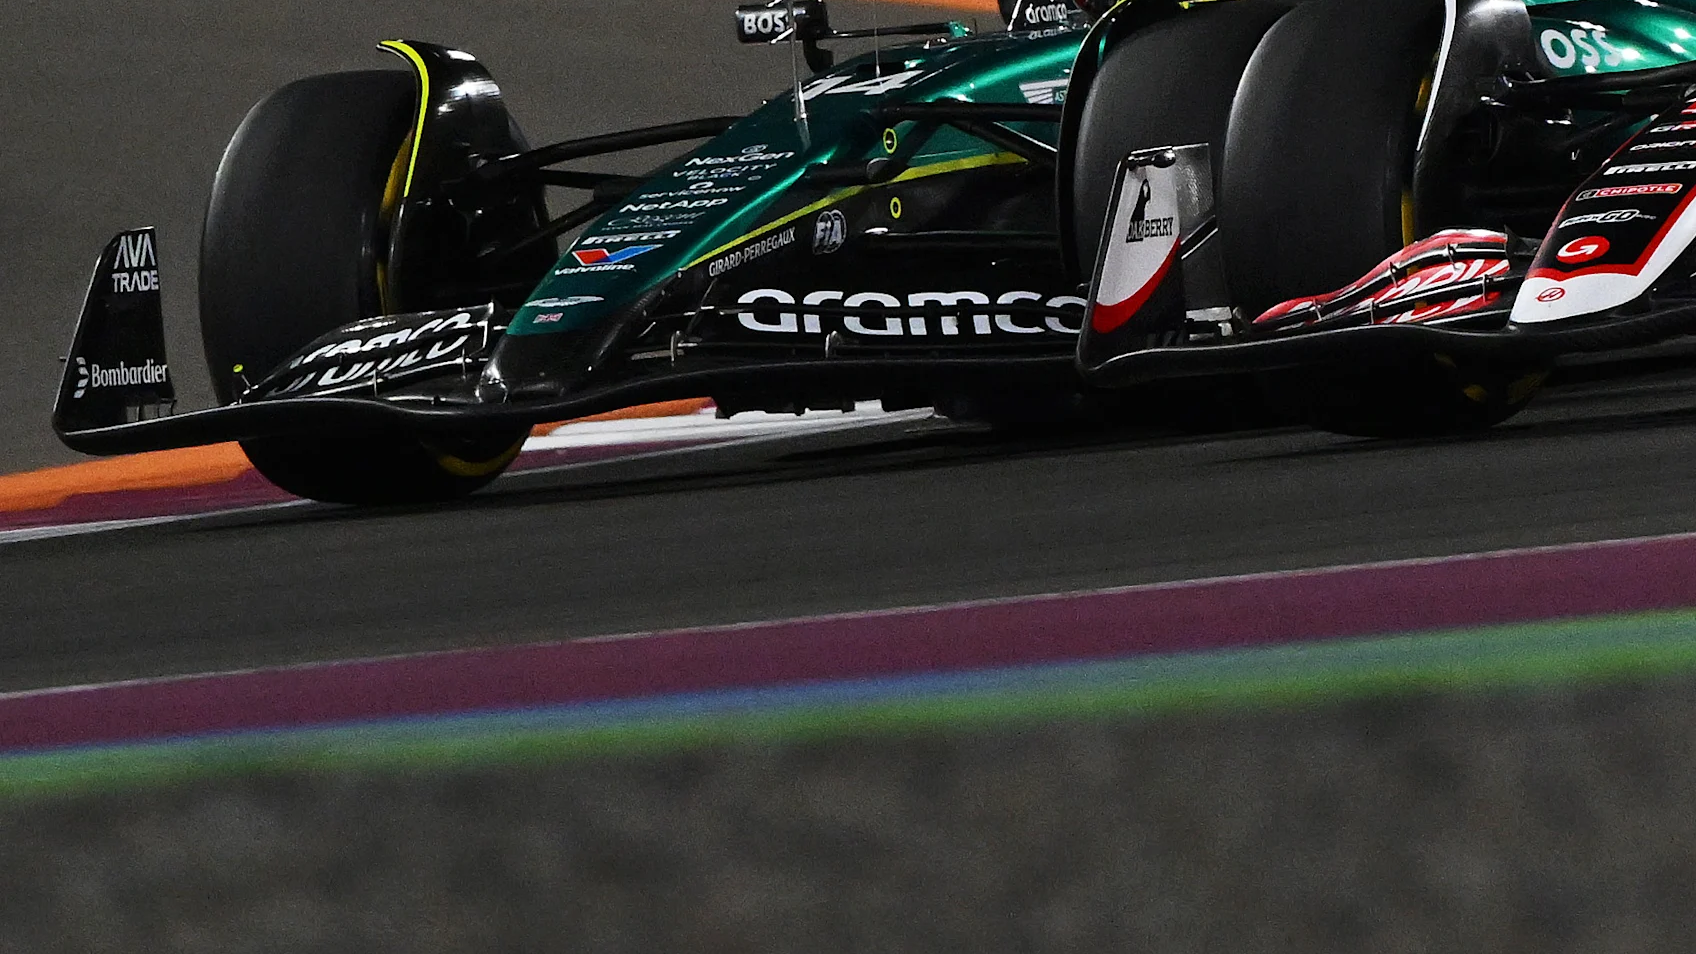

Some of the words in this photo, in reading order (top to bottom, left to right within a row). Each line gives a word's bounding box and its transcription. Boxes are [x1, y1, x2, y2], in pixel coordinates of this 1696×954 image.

[743, 12, 787, 35] BOS
[1540, 29, 1622, 69] OSS
[791, 69, 924, 101] 14
[685, 152, 795, 167] NexGen
[1599, 184, 1677, 196] CHIPOTLE
[619, 198, 728, 213] NetApp
[113, 232, 156, 270] AVA
[581, 230, 682, 246] PIRELLI
[708, 227, 796, 277] GIRARD-PERREGAUX
[112, 270, 159, 293] TRADE
[738, 288, 1087, 336] aramco
[91, 358, 168, 388] Bombardier
